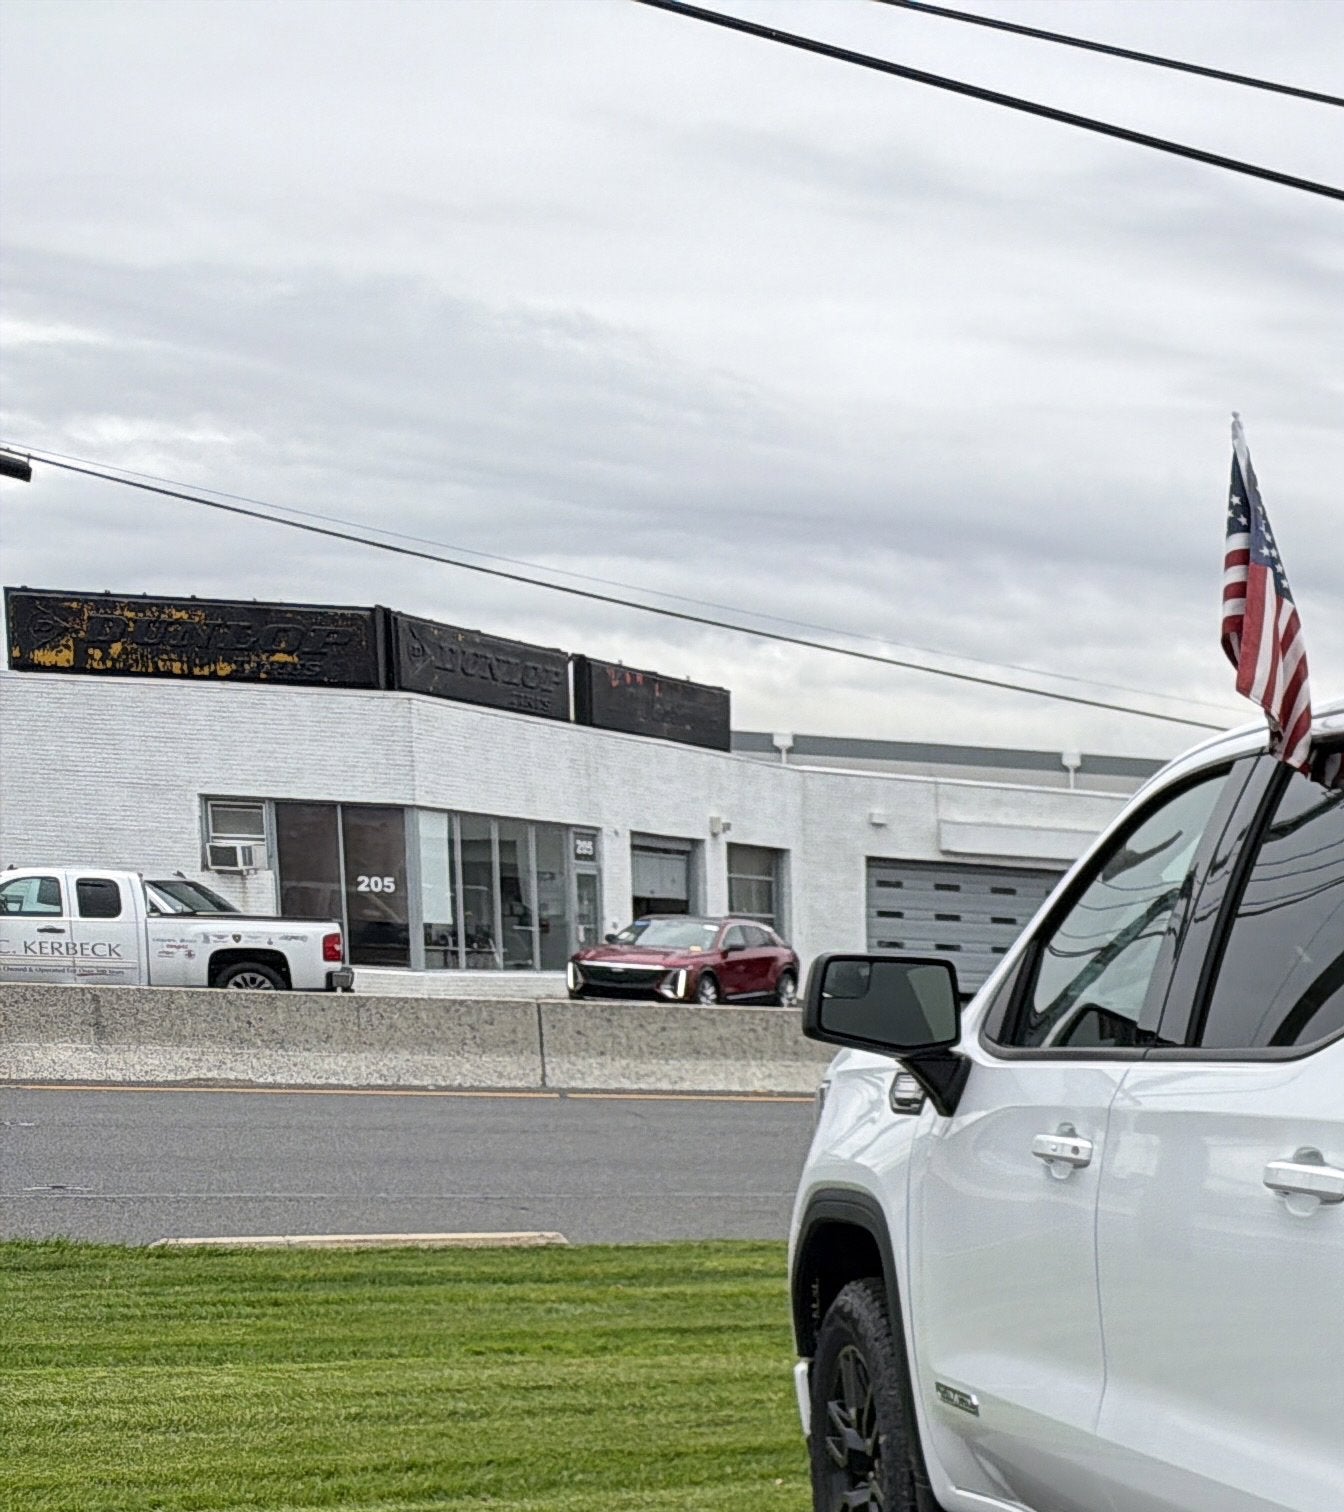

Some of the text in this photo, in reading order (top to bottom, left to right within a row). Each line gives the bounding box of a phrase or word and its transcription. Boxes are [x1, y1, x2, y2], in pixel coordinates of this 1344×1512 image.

[87, 615, 354, 656] DUNLOP
[434, 645, 562, 693] DUNLOP
[356, 875, 396, 893] 205
[23, 940, 122, 957] KERBECK
